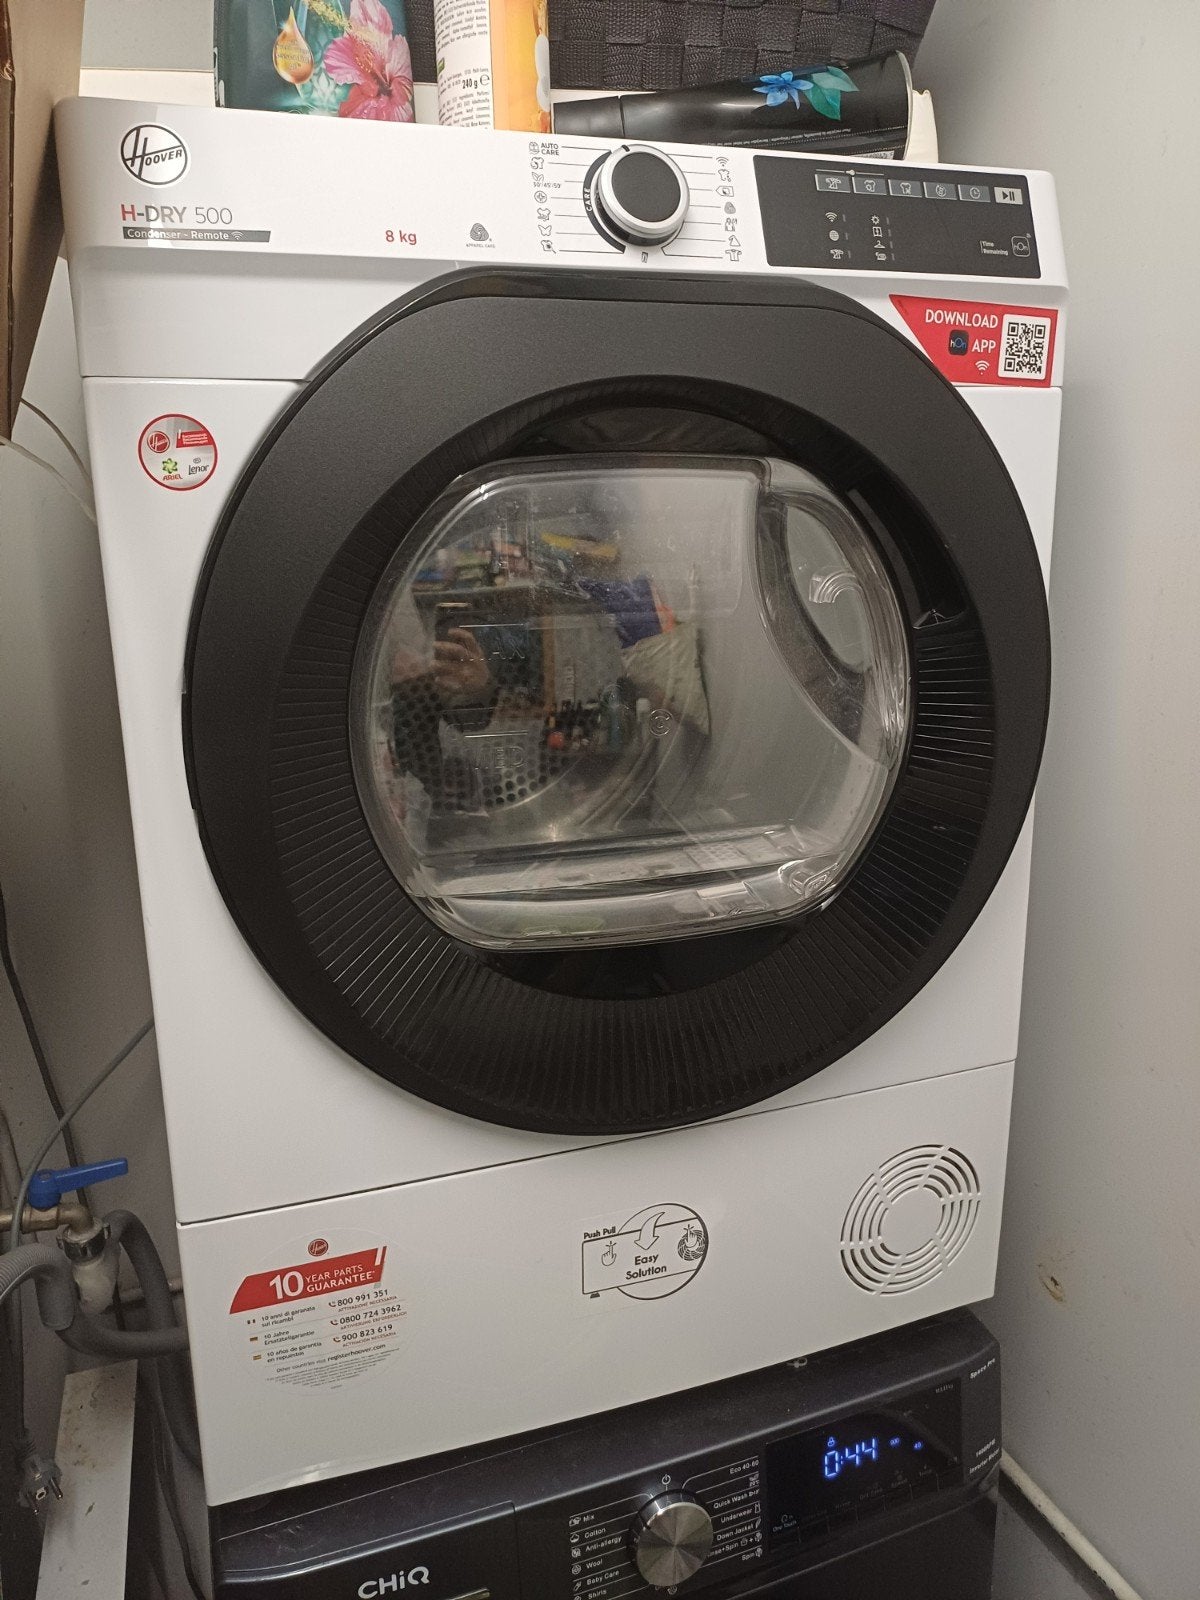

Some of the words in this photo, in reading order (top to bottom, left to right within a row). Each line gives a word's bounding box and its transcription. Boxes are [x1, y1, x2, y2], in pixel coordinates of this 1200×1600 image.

[462, 79, 473, 90] 240
[474, 80, 478, 90] g
[122, 126, 184, 177] HOOVER
[583, 188, 593, 212] CARE
[121, 204, 187, 225] H-DRY
[195, 207, 233, 226] 500
[127, 228, 181, 240] Condenser
[191, 229, 229, 242] Remote
[385, 229, 395, 243] 8
[399, 230, 418, 247] kg
[925, 309, 998, 329] DOWNLOAD
[972, 339, 996, 353] APP
[584, 1230, 601, 1239] Push
[603, 1226, 616, 1235] Pull
[634, 1253, 659, 1266] Easy
[626, 1265, 667, 1280] Solution
[269, 1270, 304, 1299] 10
[305, 1271, 330, 1283] YEAR
[334, 1264, 363, 1277] PARTS
[338, 1297, 353, 1306] 800
[355, 1293, 370, 1302] 991
[373, 1289, 388, 1298] 351
[340, 1314, 361, 1324] 0800
[363, 1310, 378, 1319] 724
[381, 1304, 401, 1315] 3962
[342, 1332, 357, 1341] 900
[360, 1328, 375, 1337] 823
[377, 1324, 393, 1332] 619
[824, 1438, 876, 1477] 0:44
[730, 1466, 741, 1475] Eco
[742, 1460, 759, 1470] 40-60
[713, 1498, 730, 1509] Quick
[731, 1493, 748, 1503] Wash
[583, 1514, 595, 1522] Mix
[721, 1508, 752, 1523] Underwear
[584, 1527, 606, 1539] Cotton
[717, 1531, 734, 1541] Down
[734, 1523, 754, 1535] Jacket
[585, 1536, 622, 1552] Anti-allergy
[586, 1558, 603, 1569] Wool
[357, 1566, 431, 1599] CHiQ
[586, 1577, 603, 1585] Baby
[604, 1570, 620, 1579] Care
